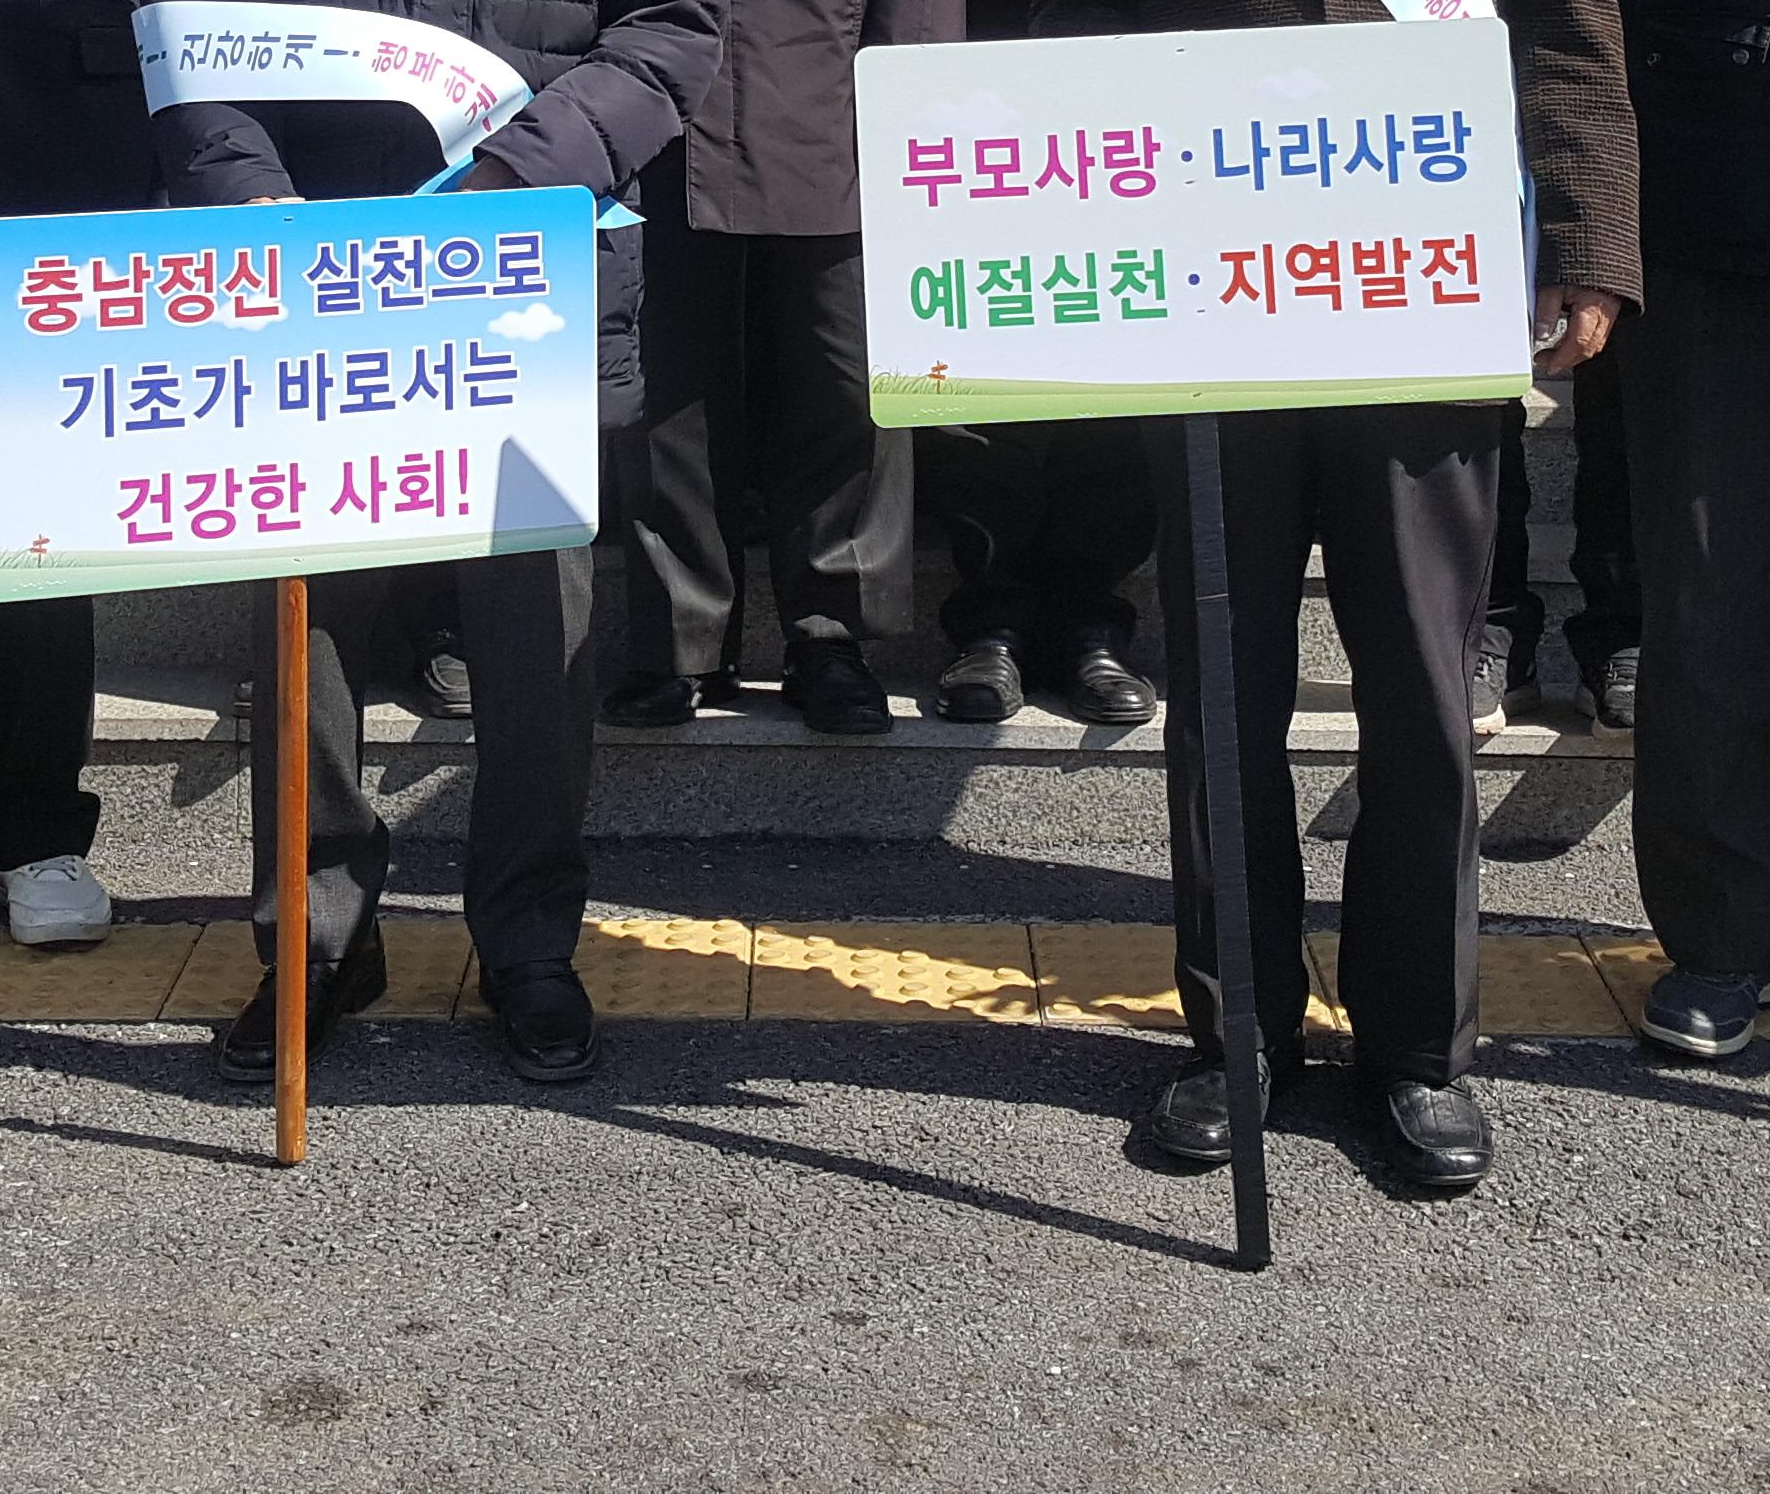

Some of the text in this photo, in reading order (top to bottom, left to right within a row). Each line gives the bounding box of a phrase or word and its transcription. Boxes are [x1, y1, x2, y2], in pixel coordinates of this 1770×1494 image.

[901, 110, 1472, 208] 부모사랑 나라사랑
[21, 232, 548, 333] 충남정신 실천으로
[909, 233, 1481, 330] 예절실천 지역발전
[60, 340, 518, 437] 기초가 바로서는
[117, 447, 469, 545] 건강한 사회!
